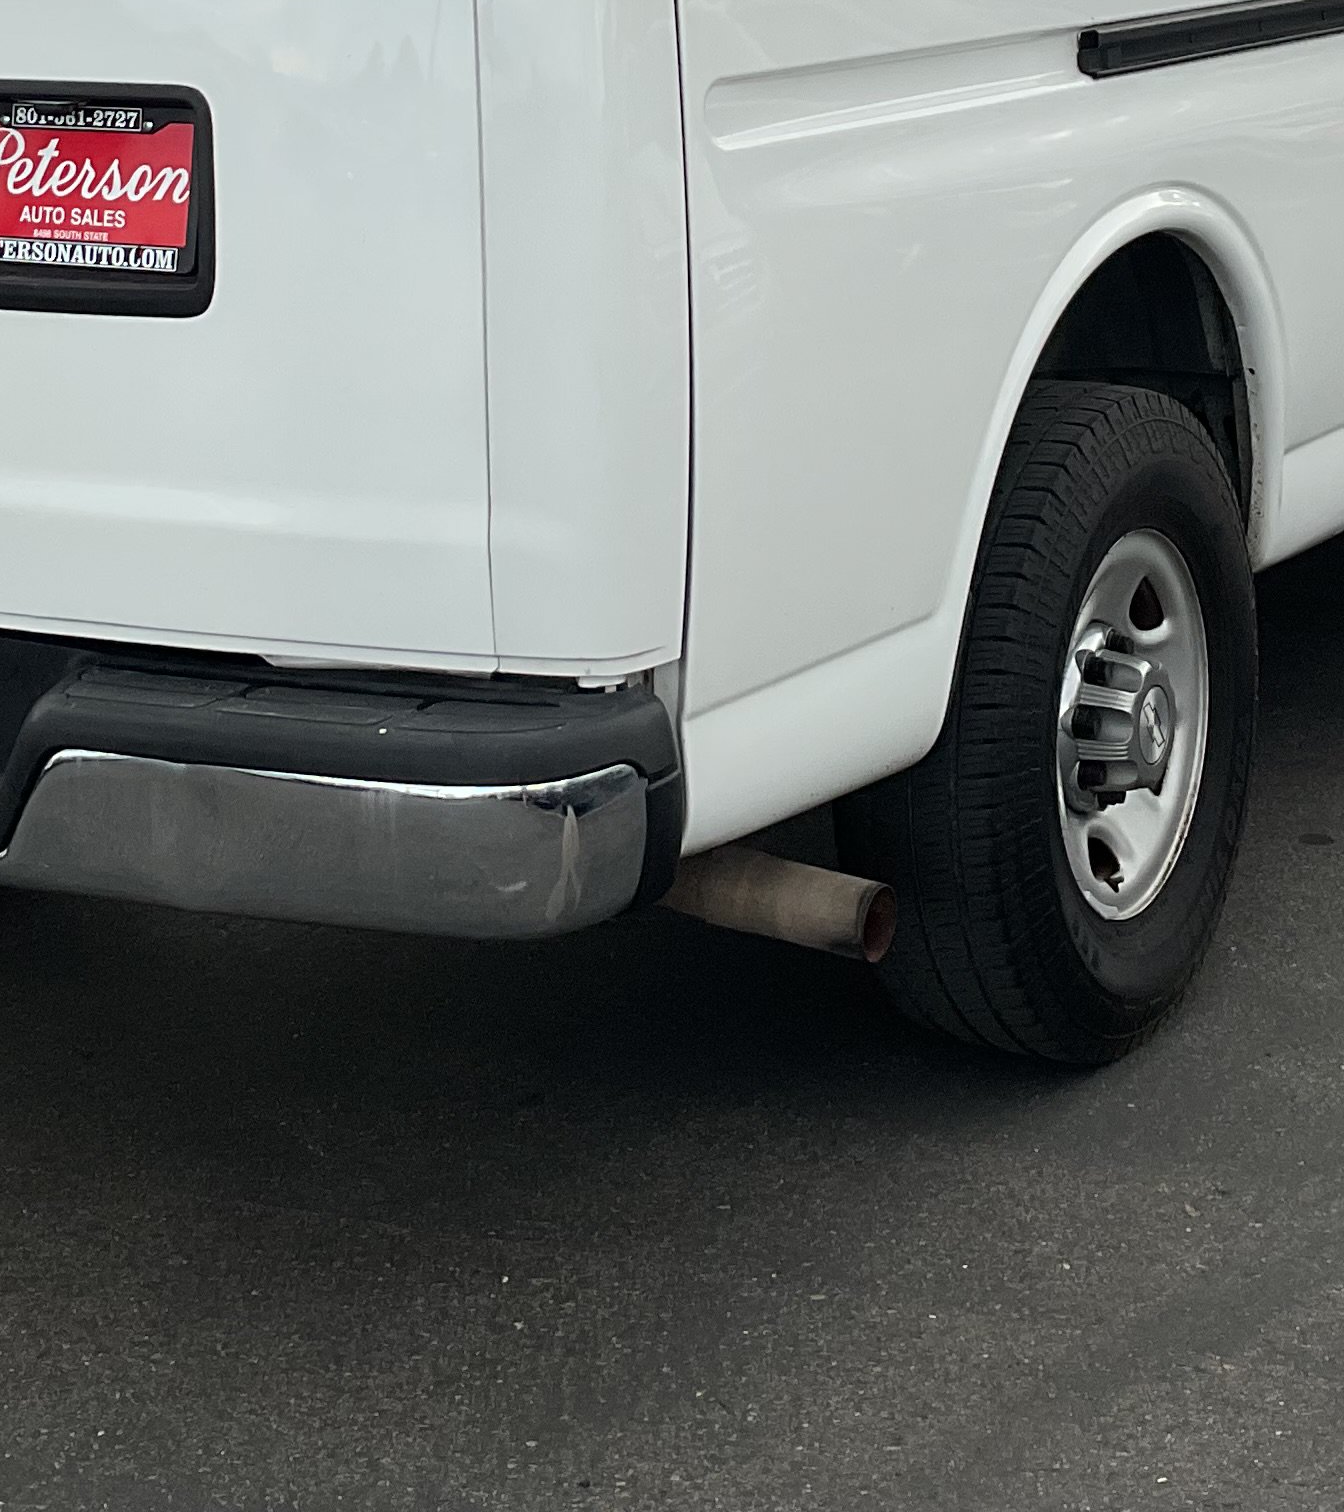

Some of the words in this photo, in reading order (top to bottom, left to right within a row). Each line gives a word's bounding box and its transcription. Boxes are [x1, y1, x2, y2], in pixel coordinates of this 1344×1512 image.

[19, 205, 65, 224] AUTO
[70, 208, 126, 227] SALES
[53, 230, 82, 240] SOUTH
[83, 231, 109, 241] STATE
